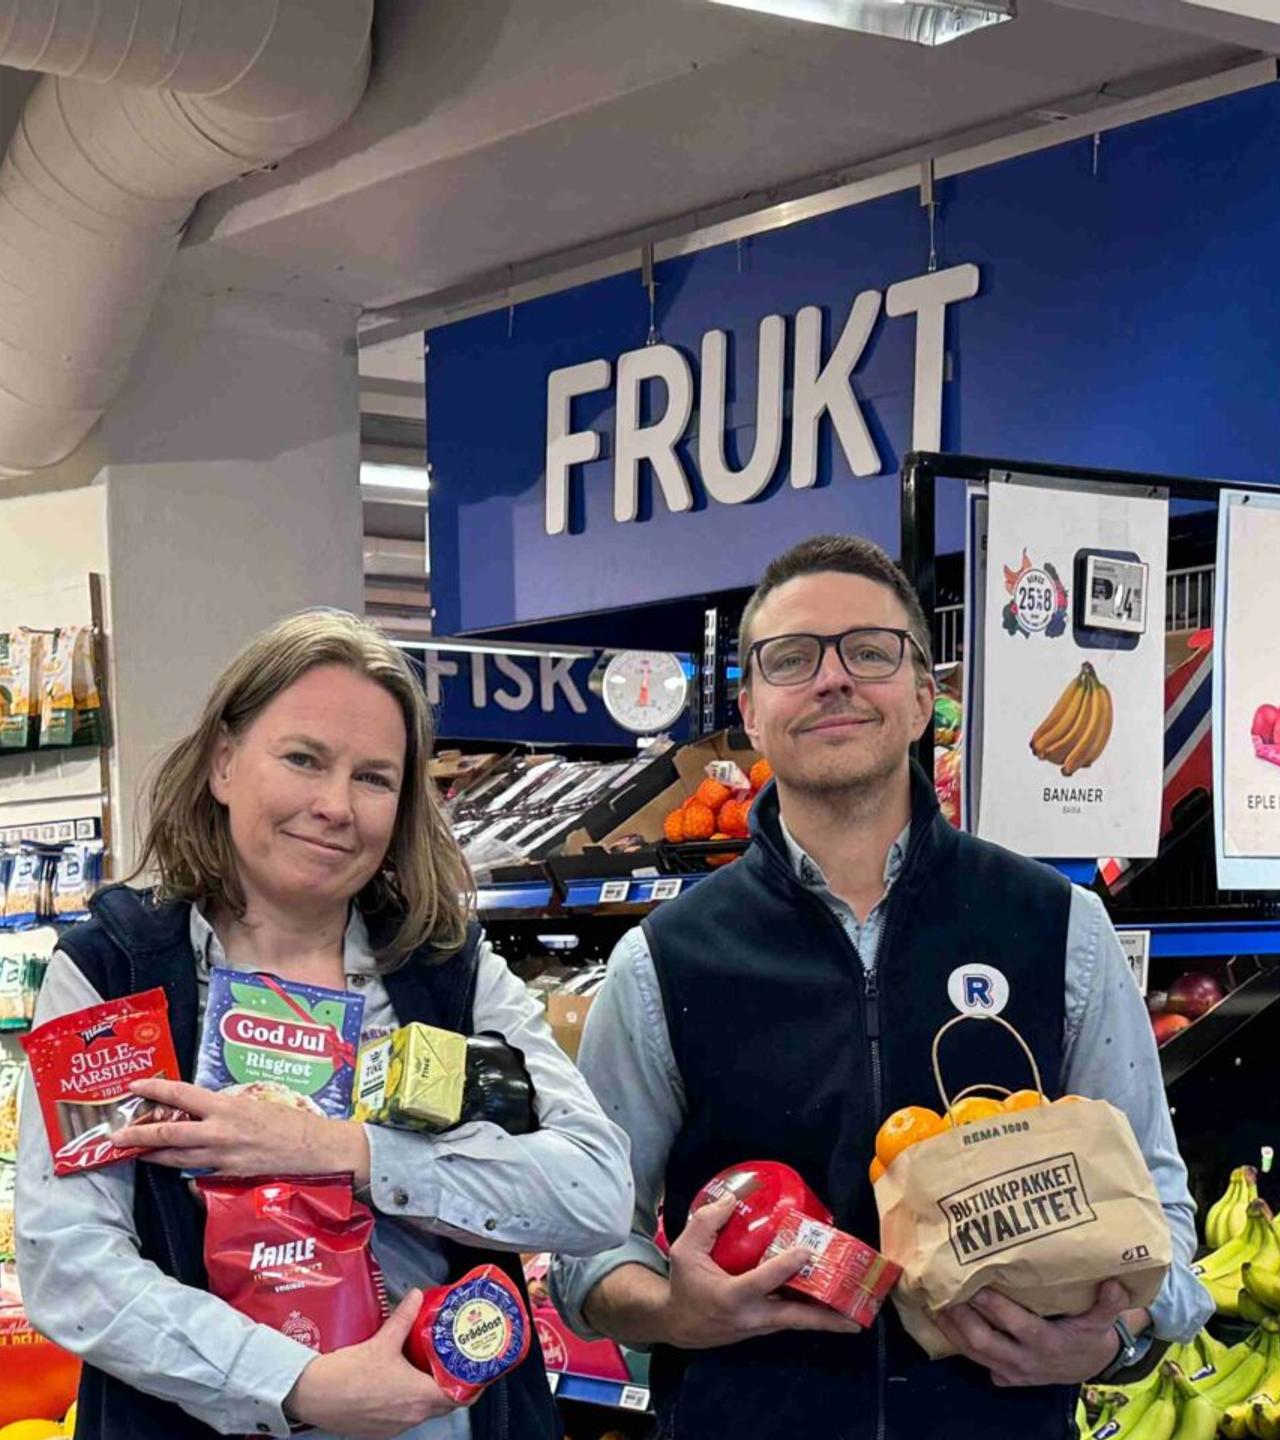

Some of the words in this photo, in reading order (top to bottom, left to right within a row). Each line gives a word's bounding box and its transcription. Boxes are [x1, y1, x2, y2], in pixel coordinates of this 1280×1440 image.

[545, 262, 980, 536] FRUKT
[425, 650, 588, 714] FISK
[1043, 787, 1103, 802] BANANER
[1247, 794, 1275, 810] EPLE
[963, 974, 994, 1008] R
[237, 1019, 284, 1045] God
[288, 1029, 326, 1052] Jul
[60, 1047, 156, 1093] MARSIPAN
[71, 1043, 136, 1074] JULE-
[245, 1051, 313, 1077] Risgrøt
[963, 1126, 1001, 1146] REMA
[1002, 1120, 1029, 1136] 1000
[949, 1164, 1073, 1224] BUTIKKPAKKET
[955, 1185, 1084, 1256] KVALITET
